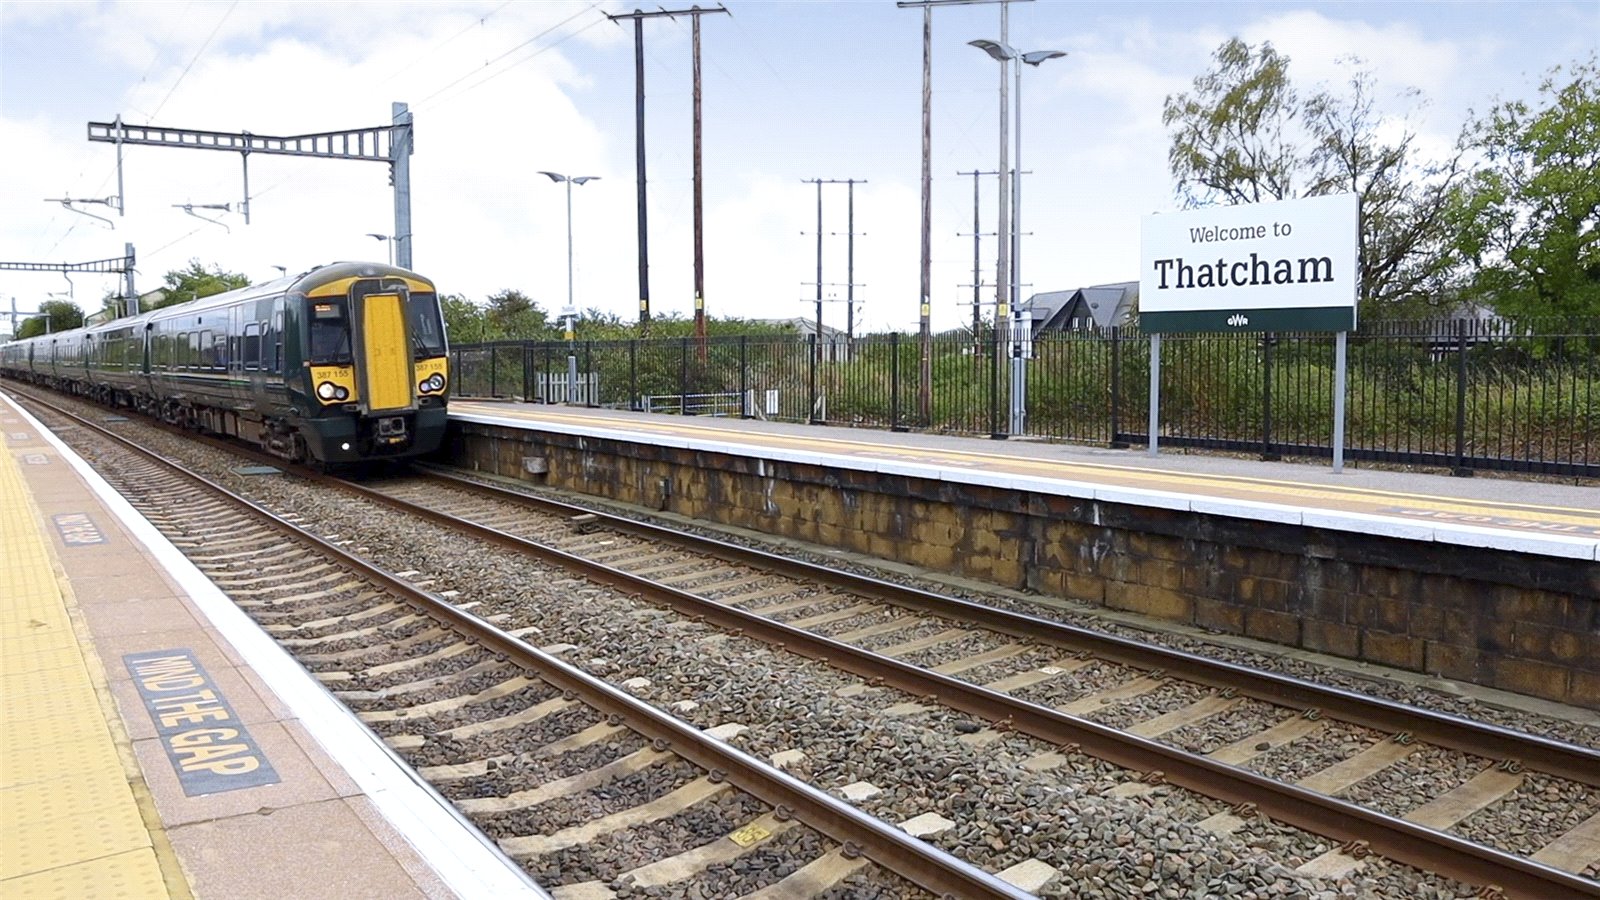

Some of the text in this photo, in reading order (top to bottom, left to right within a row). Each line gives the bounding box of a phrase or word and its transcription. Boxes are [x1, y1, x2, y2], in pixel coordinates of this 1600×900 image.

[1189, 221, 1292, 244] Welcome to
[1154, 253, 1334, 290] Thatcham
[1227, 313, 1249, 327] GWR
[316, 371, 331, 380] 387
[131, 654, 260, 776] MIND THE GAP
